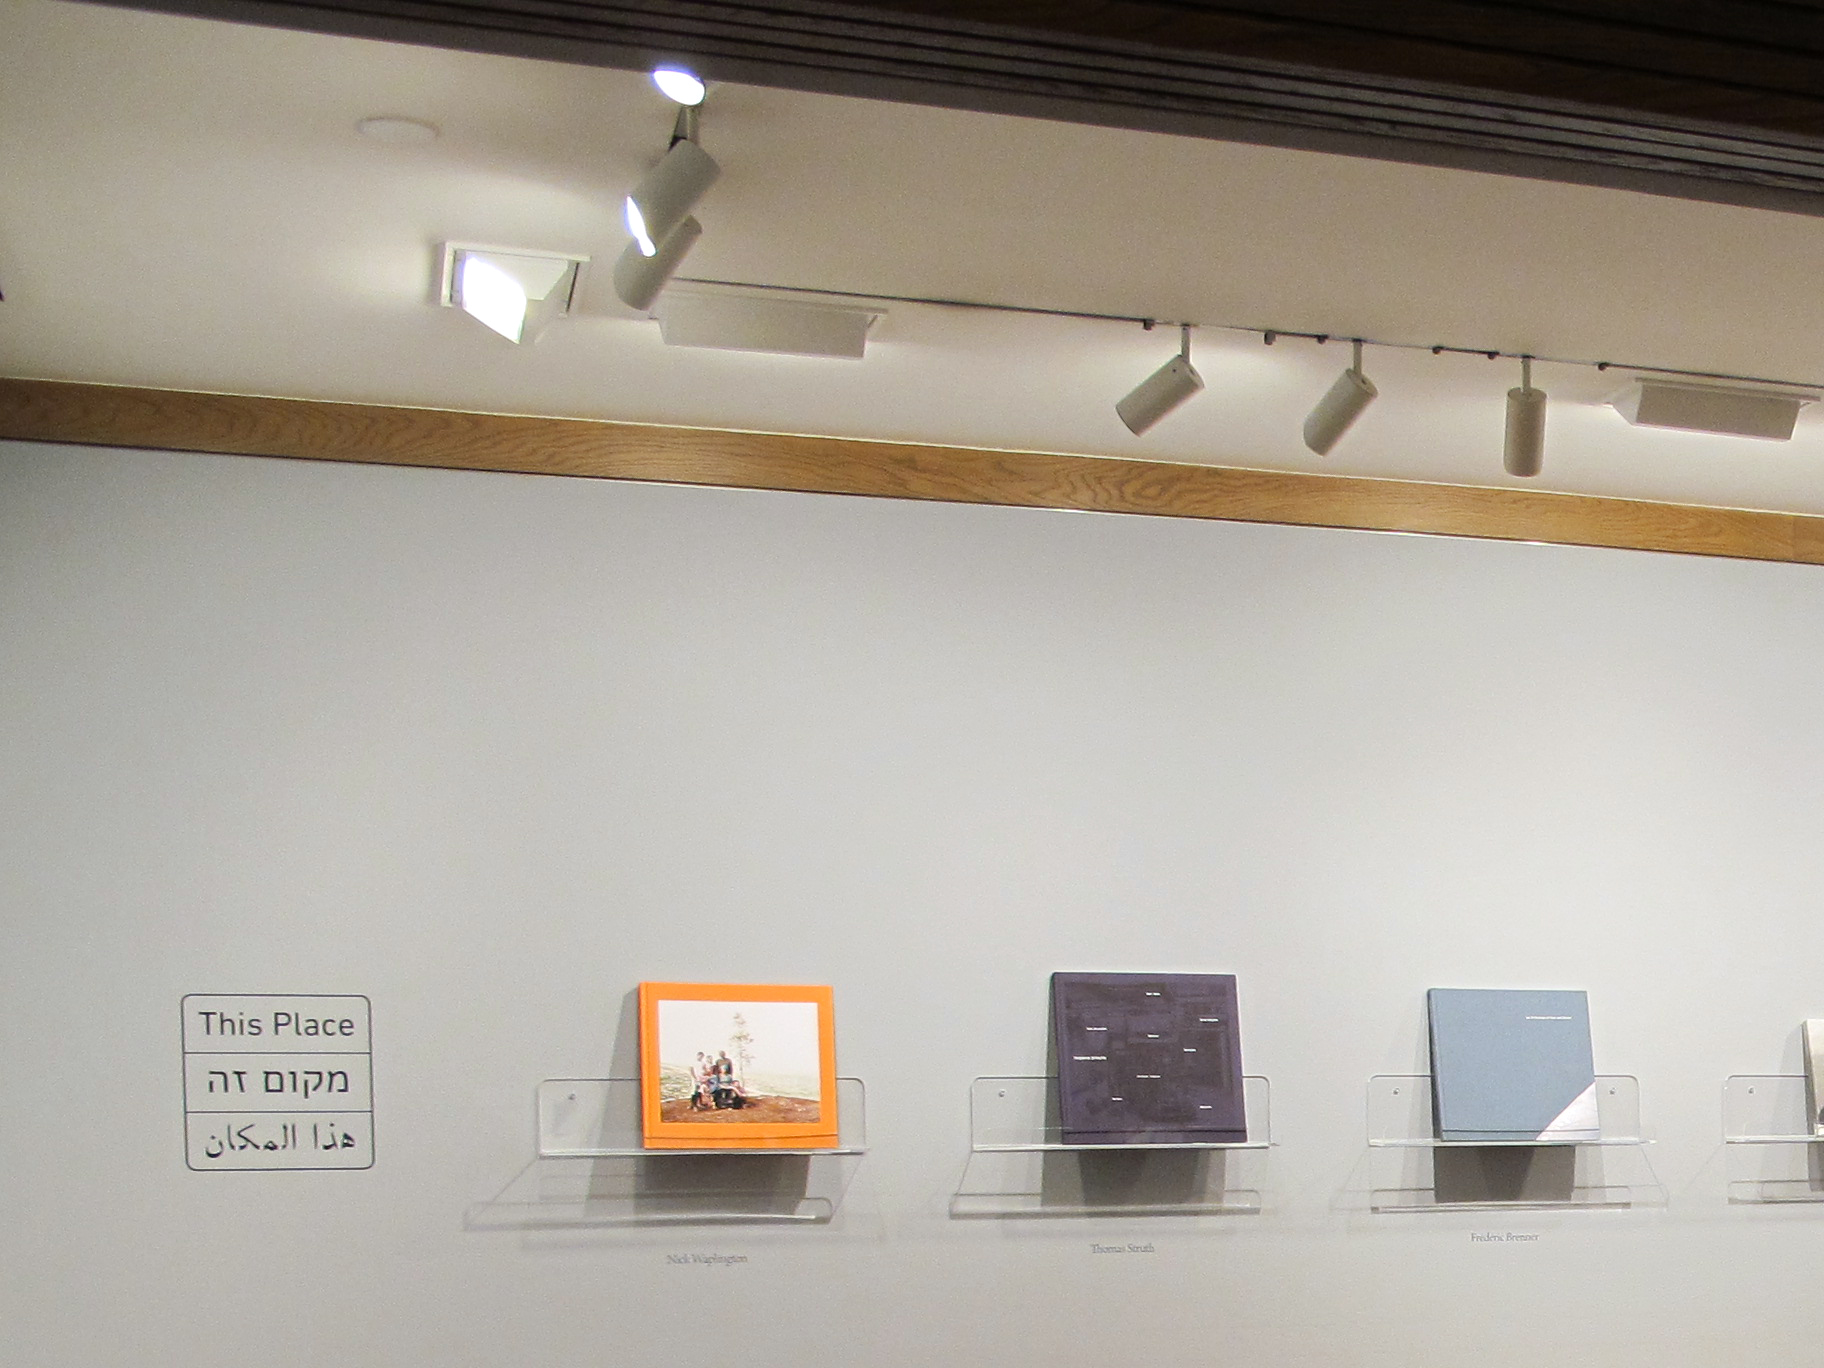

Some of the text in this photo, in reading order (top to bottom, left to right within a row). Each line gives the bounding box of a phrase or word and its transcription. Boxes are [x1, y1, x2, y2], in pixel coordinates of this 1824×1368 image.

[198, 1011, 355, 1037] This Place
[208, 1070, 349, 1100] מקום זה
[205, 1122, 355, 1159] هذا المكان
[1090, 1242, 1155, 1254] Thomas Struth
